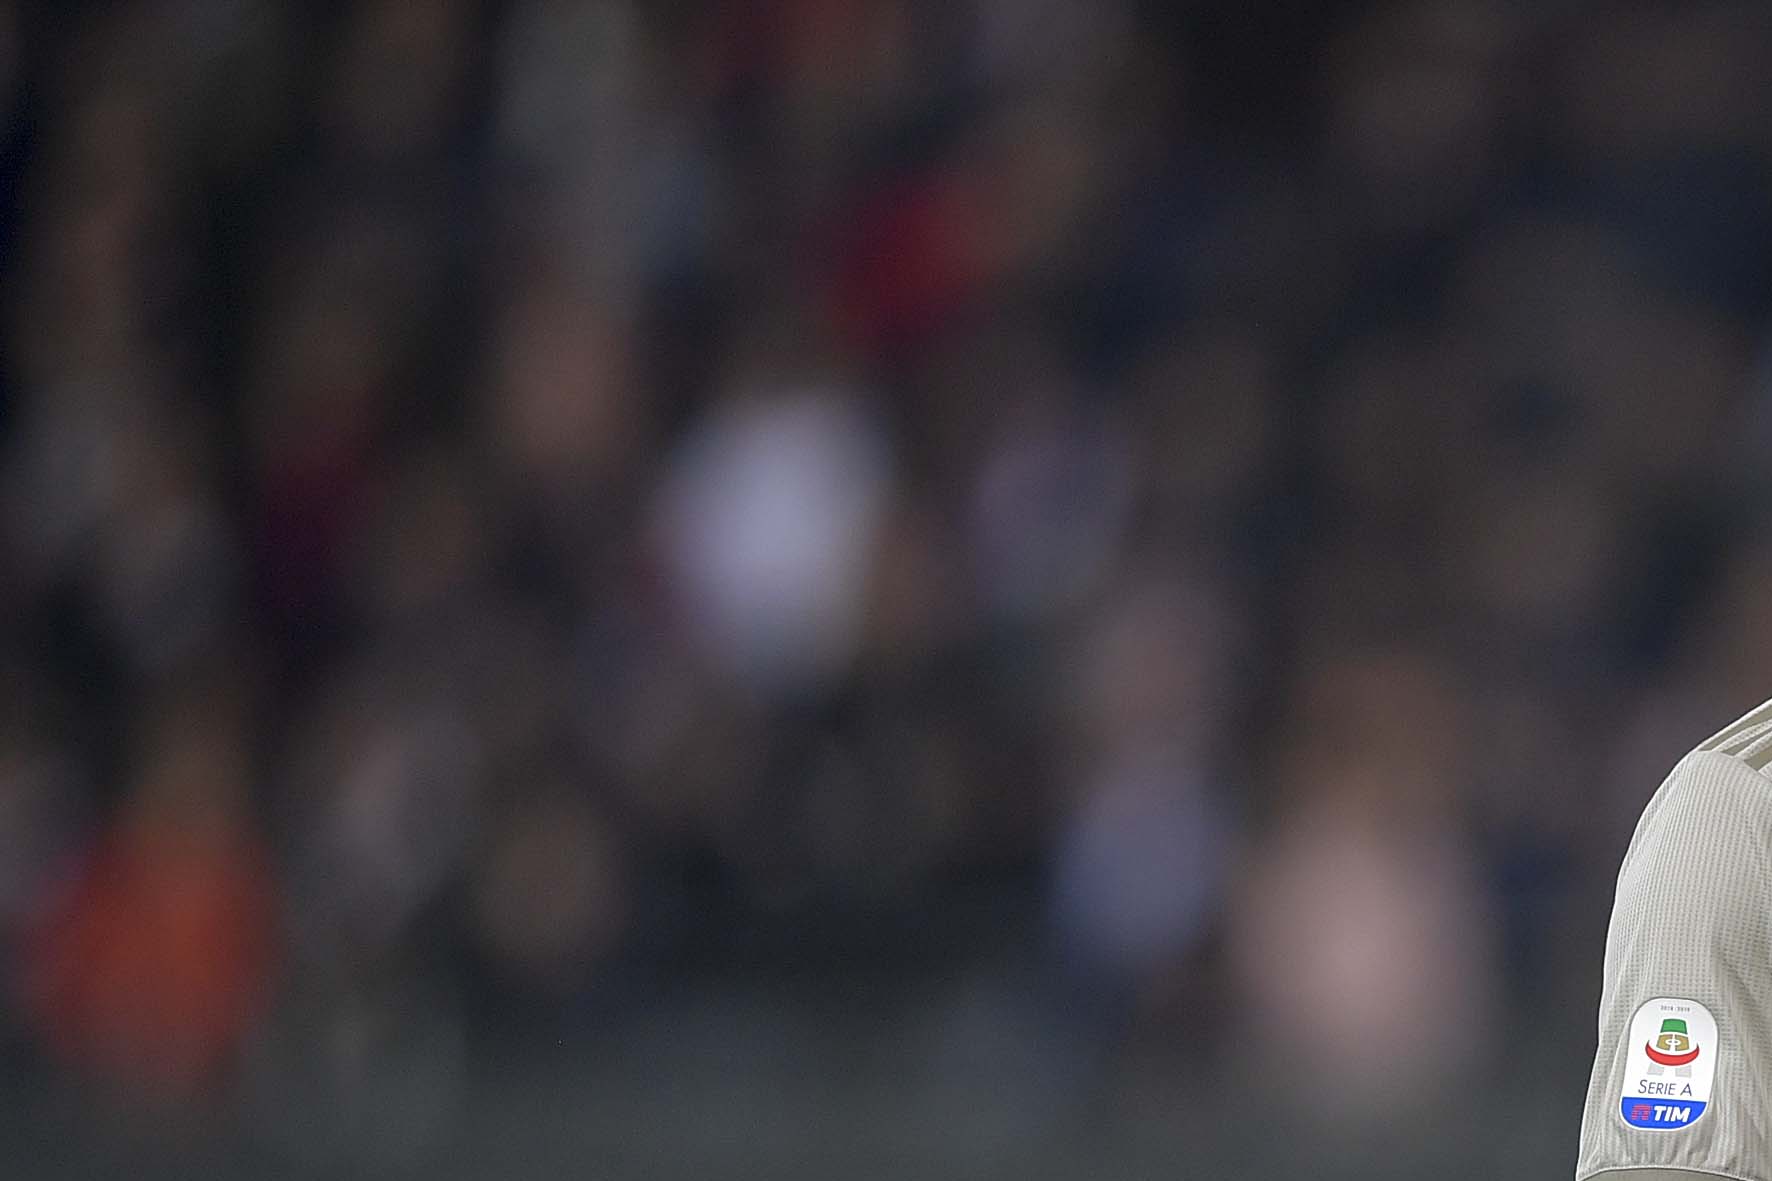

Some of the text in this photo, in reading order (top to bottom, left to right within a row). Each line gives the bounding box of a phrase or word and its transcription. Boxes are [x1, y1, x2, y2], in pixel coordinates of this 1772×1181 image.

[1638, 1079, 1692, 1097] SERIE A
[1653, 1105, 1691, 1123] TIM
